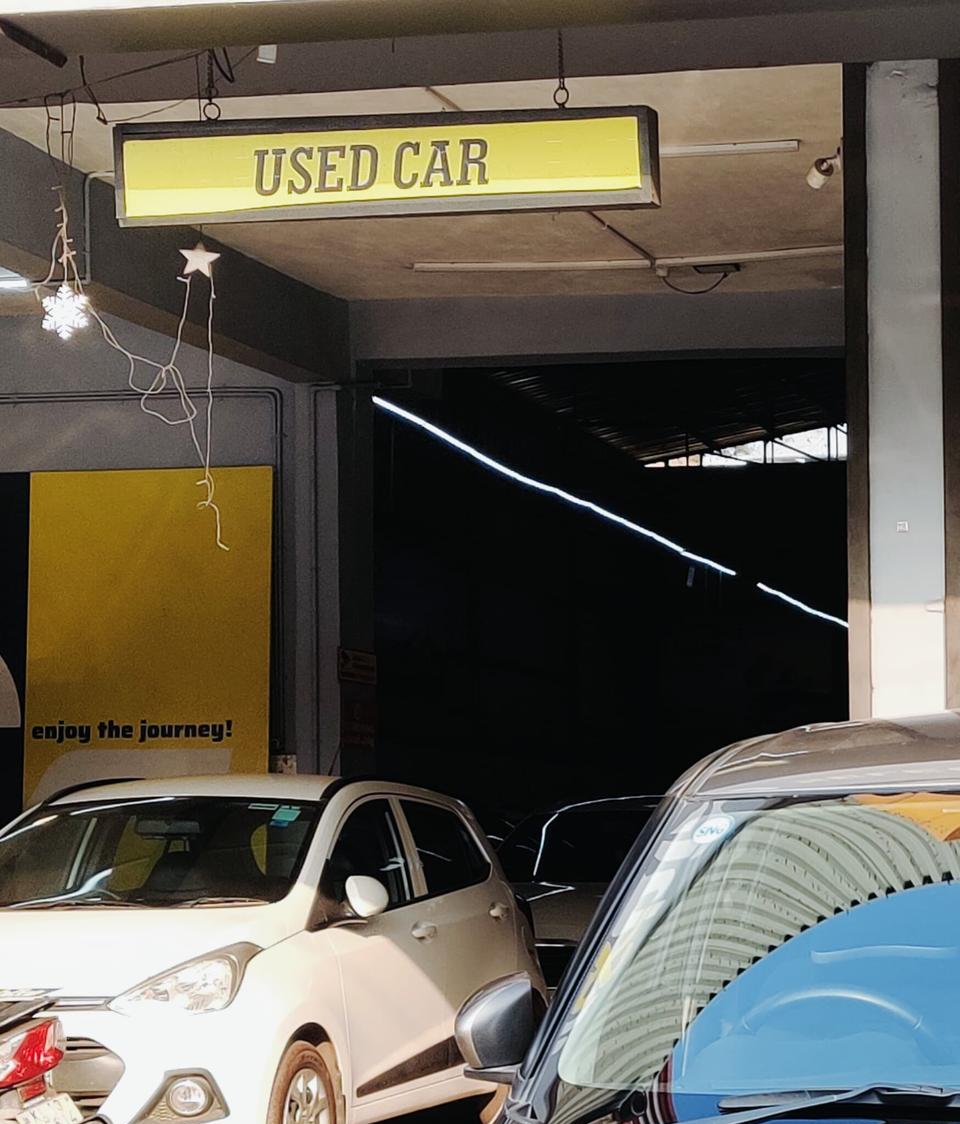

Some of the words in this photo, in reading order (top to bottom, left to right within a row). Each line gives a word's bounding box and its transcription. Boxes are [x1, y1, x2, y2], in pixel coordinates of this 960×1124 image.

[254, 145, 379, 196] USED
[394, 139, 489, 188] CAR
[31, 720, 91, 744] enjoy
[98, 720, 133, 739] the
[138, 719, 233, 743] journey!
